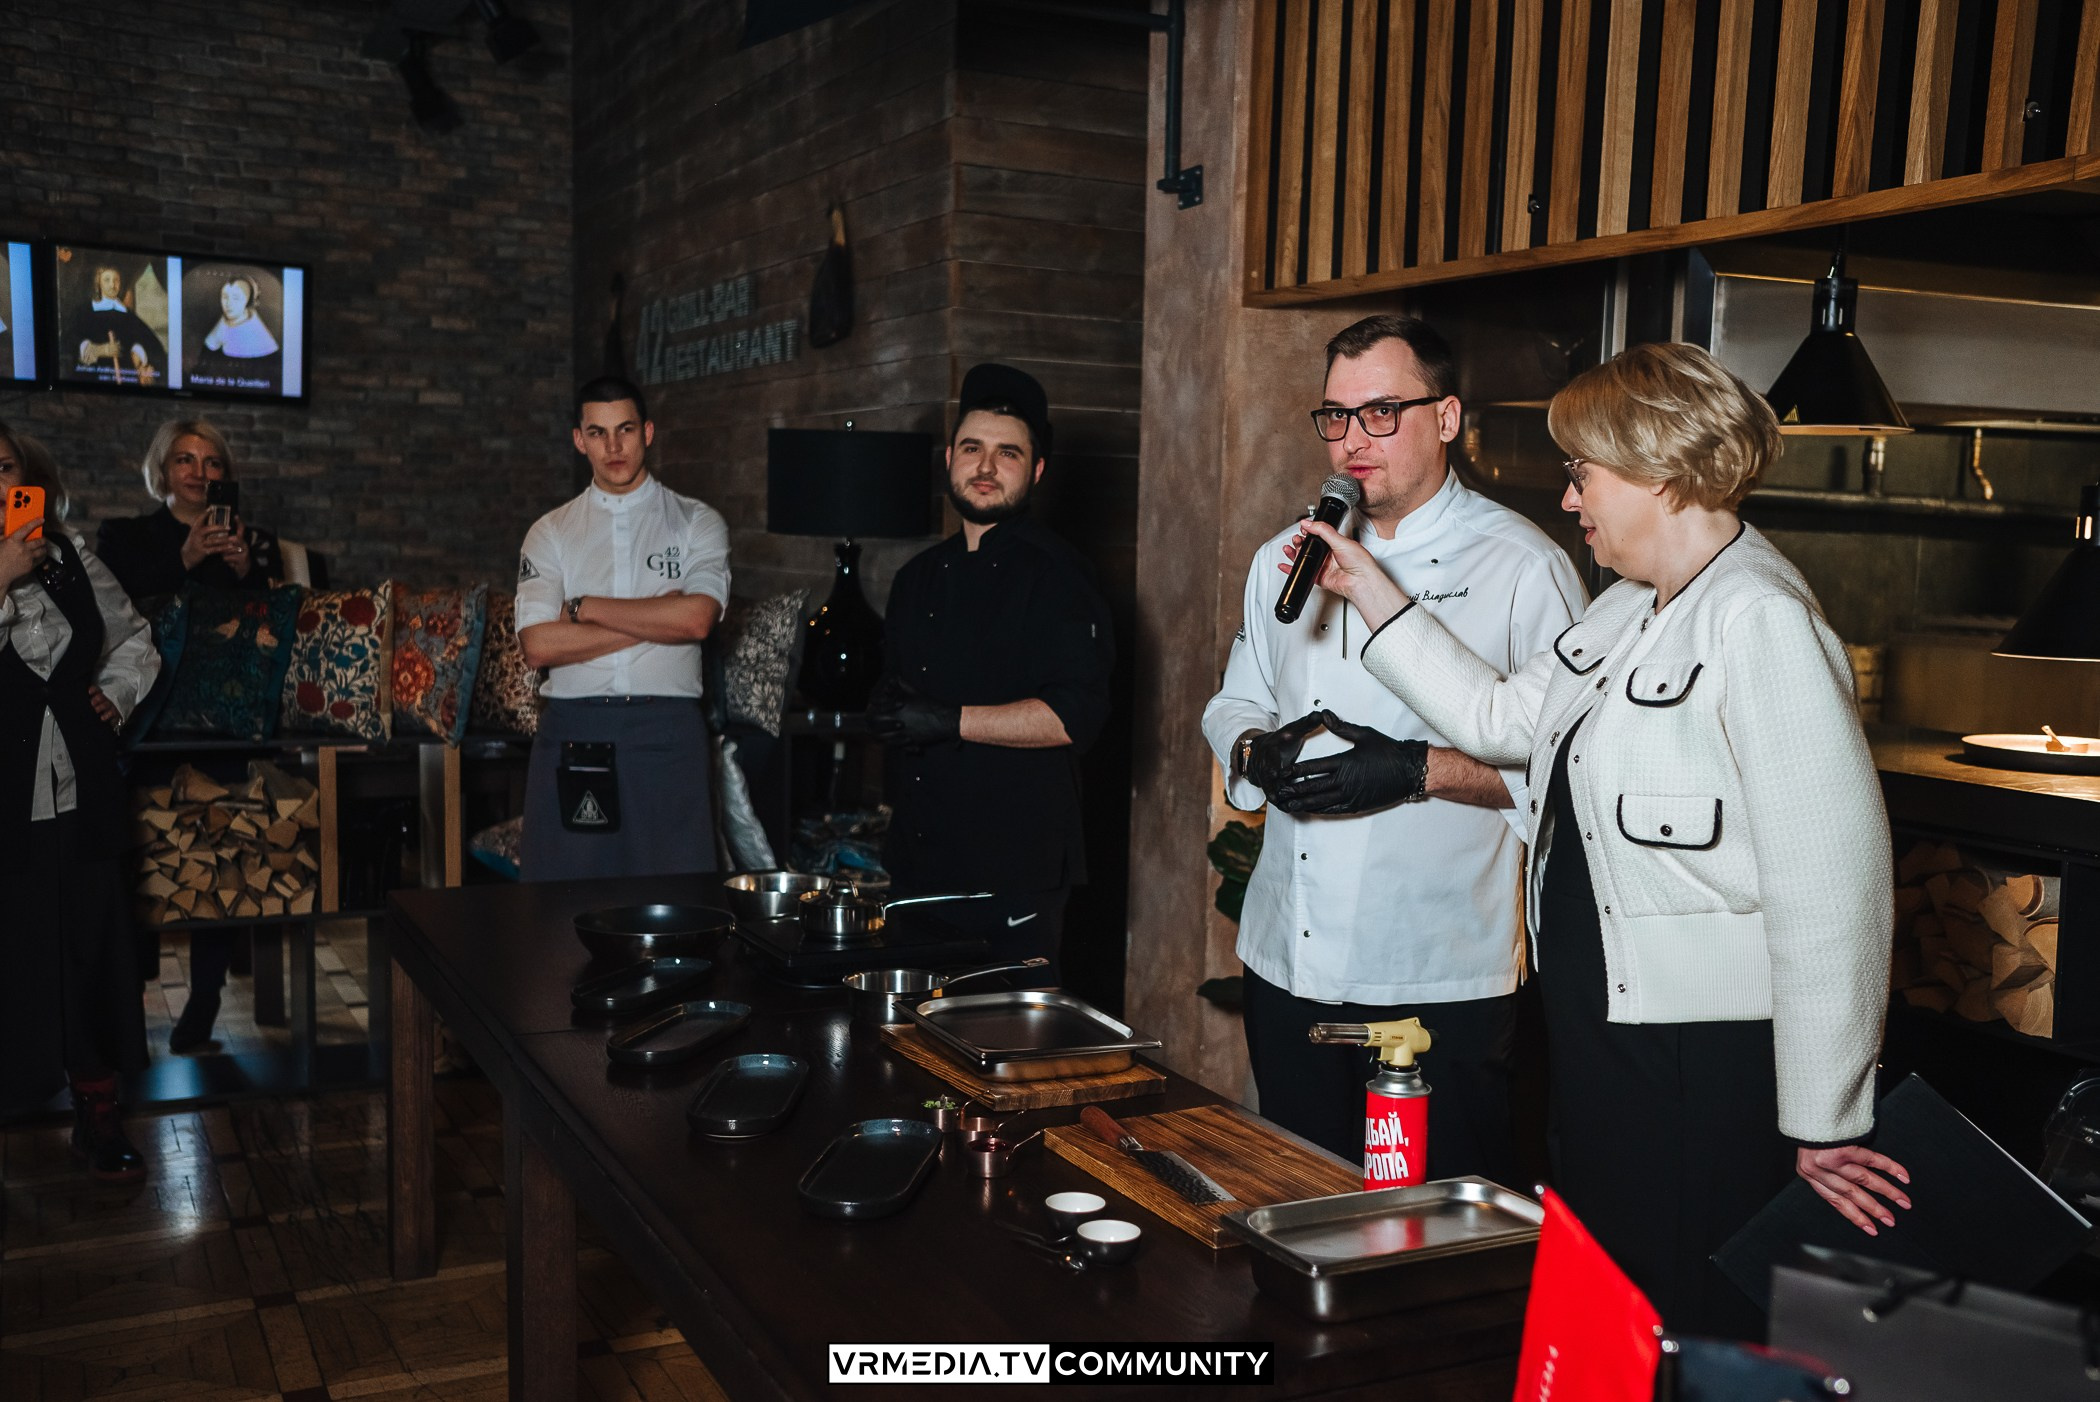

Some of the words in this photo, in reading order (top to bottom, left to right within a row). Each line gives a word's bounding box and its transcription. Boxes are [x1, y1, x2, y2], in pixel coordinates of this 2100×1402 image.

[662, 318, 798, 384] RESTAURANT
[664, 545, 681, 558] 42
[1421, 586, 1469, 603] Владислав
[1363, 1151, 1409, 1181] РОПА
